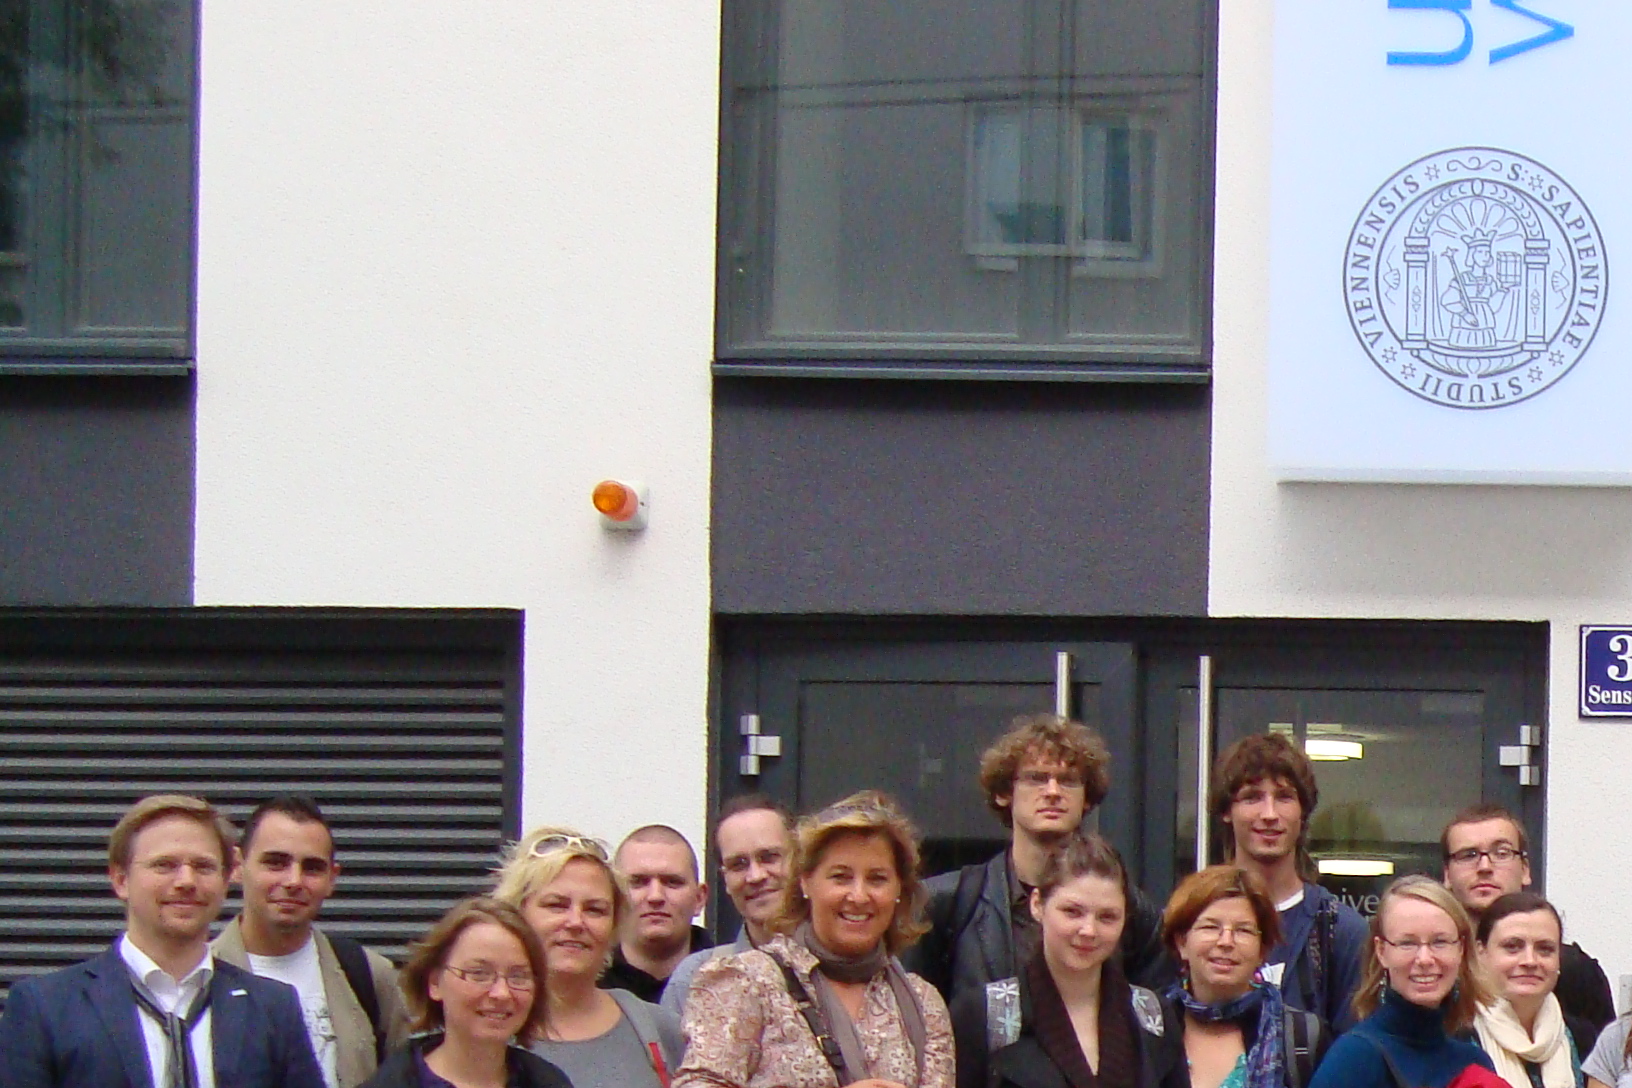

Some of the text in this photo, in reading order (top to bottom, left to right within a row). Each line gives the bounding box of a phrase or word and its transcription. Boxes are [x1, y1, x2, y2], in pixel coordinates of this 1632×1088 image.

[1350, 174, 1421, 350] VIENNENSIS
[1541, 183, 1600, 351] SAPIENTIAE
[1418, 372, 1524, 403] STUDII
